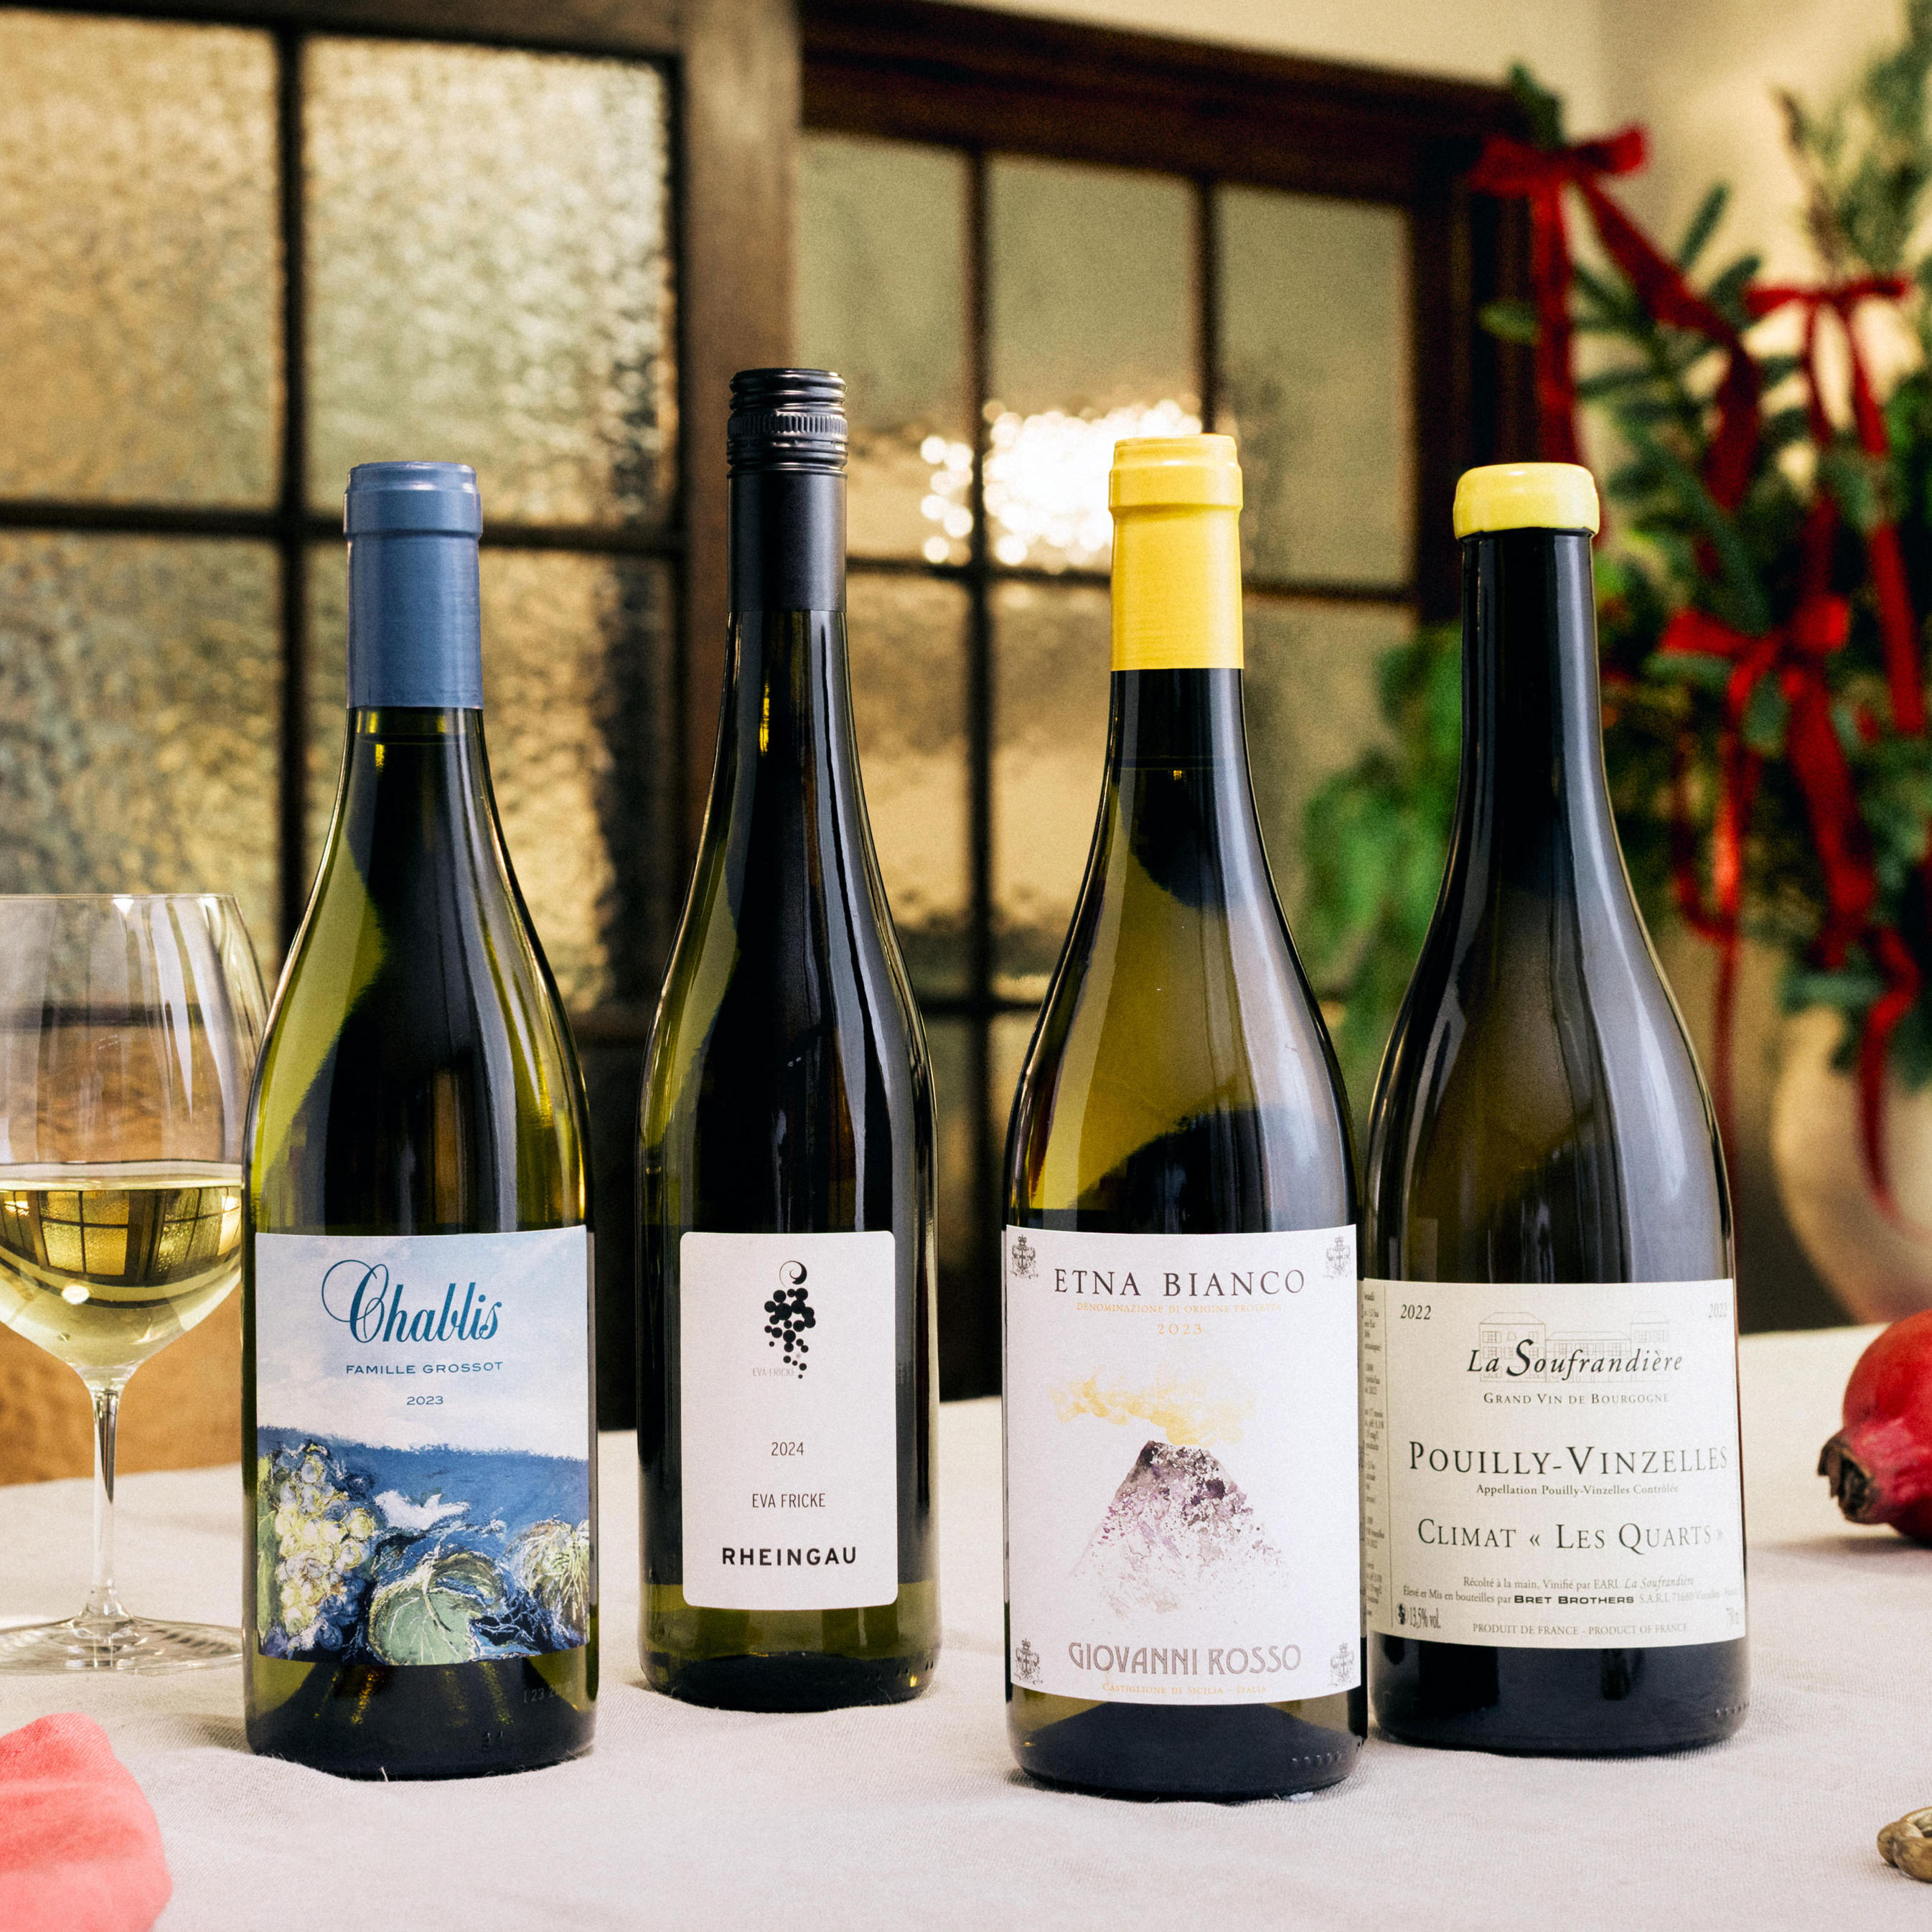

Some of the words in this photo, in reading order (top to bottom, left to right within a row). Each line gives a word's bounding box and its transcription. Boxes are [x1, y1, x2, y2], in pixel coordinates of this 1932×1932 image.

[1054, 1269, 1141, 1297] ETNA
[1163, 1269, 1305, 1297] BIANCO
[322, 1260, 502, 1343] Chablis
[1077, 1302, 1163, 1314] DENOMINAZIONE
[1168, 1305, 1180, 1314] DI
[1184, 1304, 1229, 1314] ORIGINE
[1400, 1303, 1431, 1321] 2022
[1157, 1323, 1203, 1335] 2023
[1467, 1349, 1500, 1372] La
[1506, 1338, 1682, 1381] Soufrandière
[347, 1365, 416, 1374] FAMILLE
[423, 1362, 503, 1373] GROSSOT
[407, 1396, 444, 1405] 2023
[1483, 1392, 1531, 1404] GRAND
[1537, 1393, 1562, 1404] VIN
[1569, 1394, 1585, 1404] DE
[1591, 1392, 1669, 1404] BOURGOGNE
[771, 1442, 804, 1456] 2024
[1410, 1440, 1728, 1476] POUILLY-VINZELLES
[1476, 1484, 1537, 1495] Appellation
[1542, 1484, 1630, 1497] Pouilly-Vinzelles
[1633, 1483, 1679, 1494] Contrôlée
[752, 1493, 776, 1508] EVA
[781, 1493, 825, 1508] FRICKE
[1418, 1518, 1516, 1547] CLIMAT
[1555, 1524, 1605, 1549] LES
[1618, 1523, 1712, 1555] QUARTS
[723, 1546, 857, 1566] RHEINGAU
[1463, 1577, 1493, 1587] Récolté
[1496, 1578, 1501, 1587] à
[1504, 1580, 1511, 1588] la
[1514, 1580, 1539, 1589] main,
[1543, 1580, 1573, 1589] Vinifié
[1576, 1580, 1590, 1591] par
[1624, 1578, 1638, 1589] La
[1429, 1589, 1443, 1598] Mis
[1455, 1593, 1494, 1602] bouteilles
[1497, 1595, 1510, 1605] par
[1558, 1595, 1634, 1605] BROTHERS
[1473, 1623, 1516, 1633] PRODUIT
[1521, 1624, 1534, 1633] DE
[1538, 1626, 1577, 1635] FRANCE
[1588, 1625, 1636, 1635] PRODUCT
[1639, 1625, 1651, 1634] OF
[1655, 1623, 1687, 1633] FRANCE
[1069, 1642, 1198, 1675] GIOVANNI
[1208, 1643, 1301, 1675] ROSSO
[1102, 1682, 1166, 1694] CASTIGLIONE
[1187, 1685, 1223, 1695] SICILIA
[1237, 1684, 1266, 1694] ITALIA
